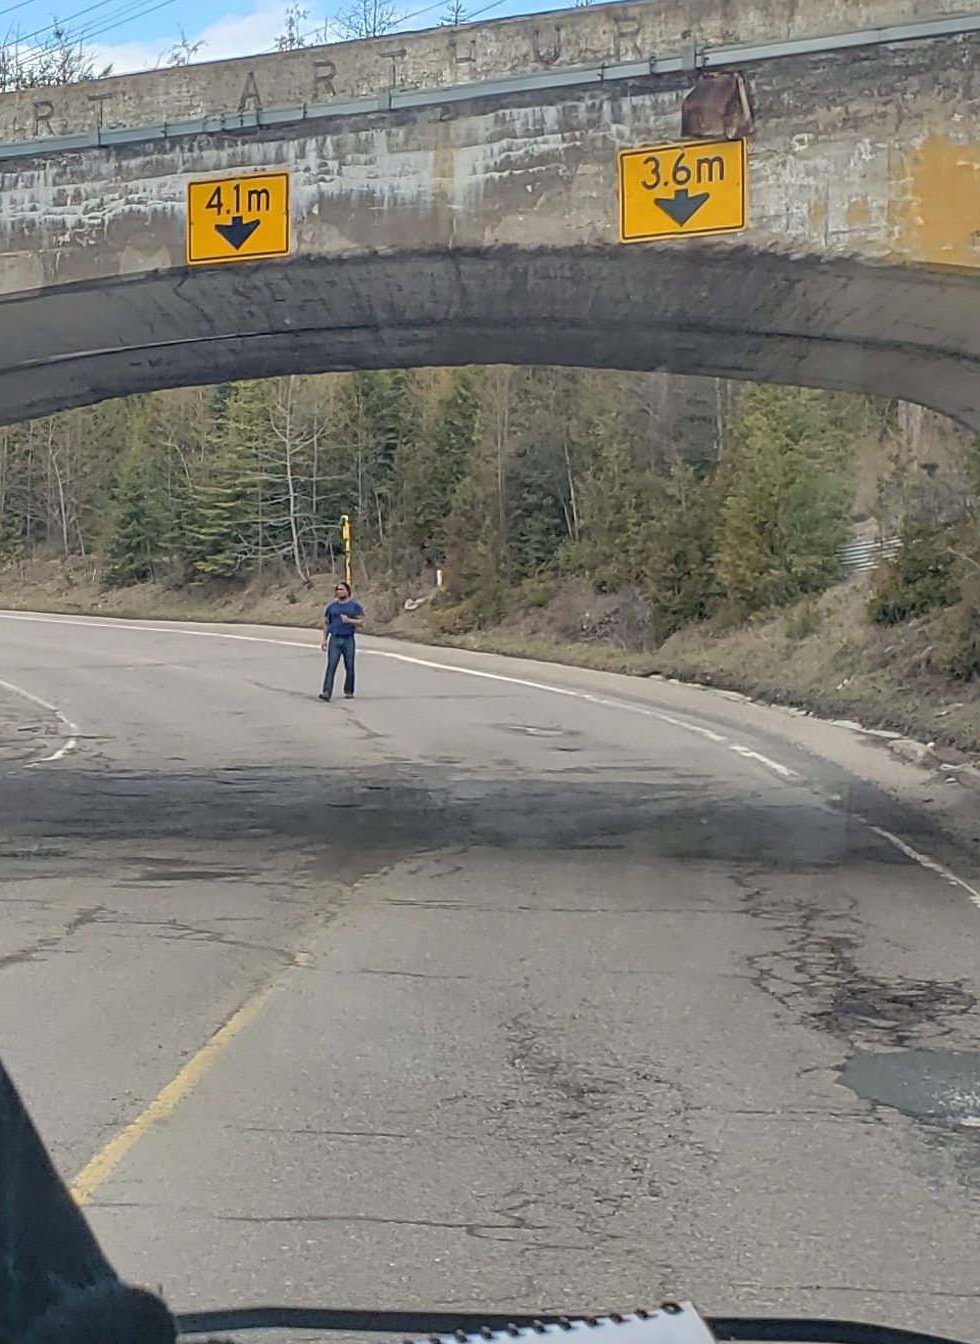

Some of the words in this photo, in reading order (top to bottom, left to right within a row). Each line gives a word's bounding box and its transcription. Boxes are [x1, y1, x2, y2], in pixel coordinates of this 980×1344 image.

[236, 18, 642, 113] ARTHUR
[640, 152, 725, 191] 3.6m
[205, 183, 270, 216] 4.1m
